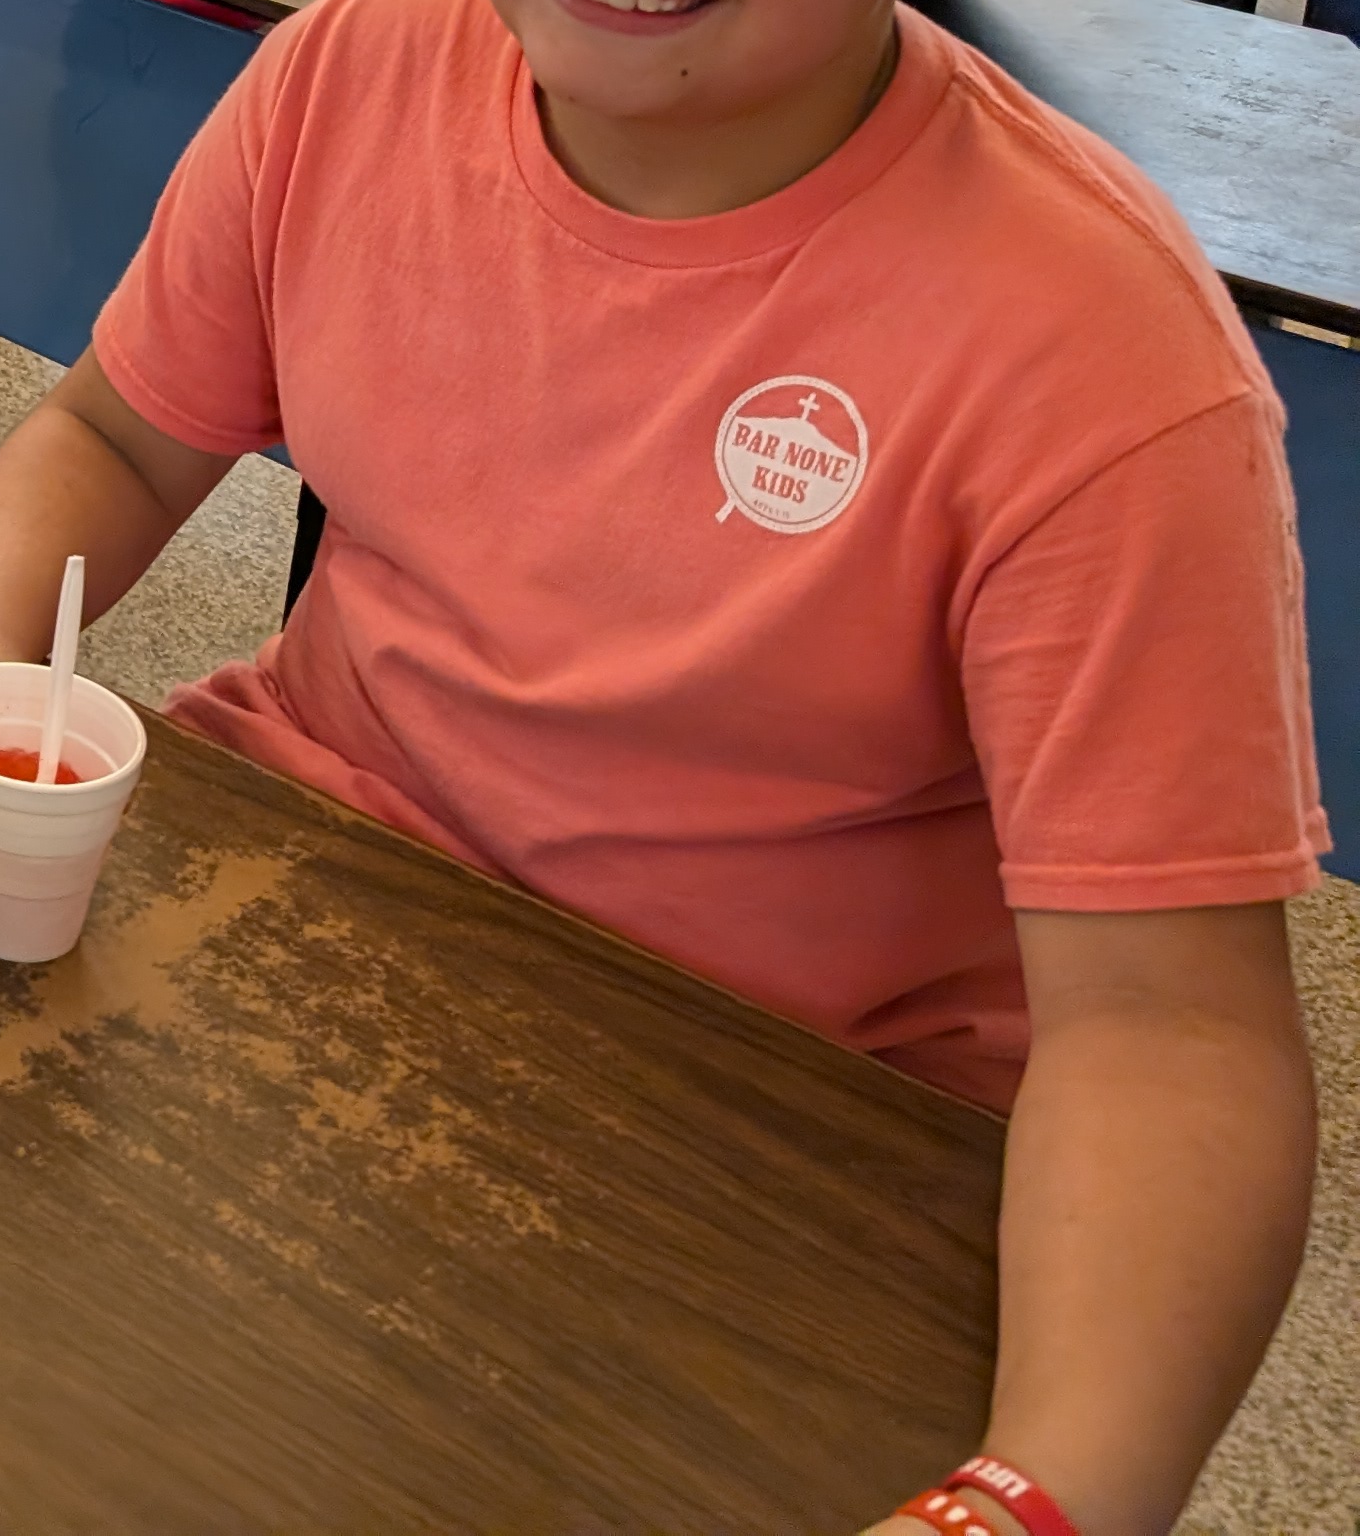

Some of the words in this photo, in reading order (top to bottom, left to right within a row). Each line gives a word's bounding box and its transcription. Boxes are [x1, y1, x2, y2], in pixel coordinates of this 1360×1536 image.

[731, 422, 780, 461] BAR
[782, 441, 851, 483] NONE
[751, 464, 809, 504] KIDS
